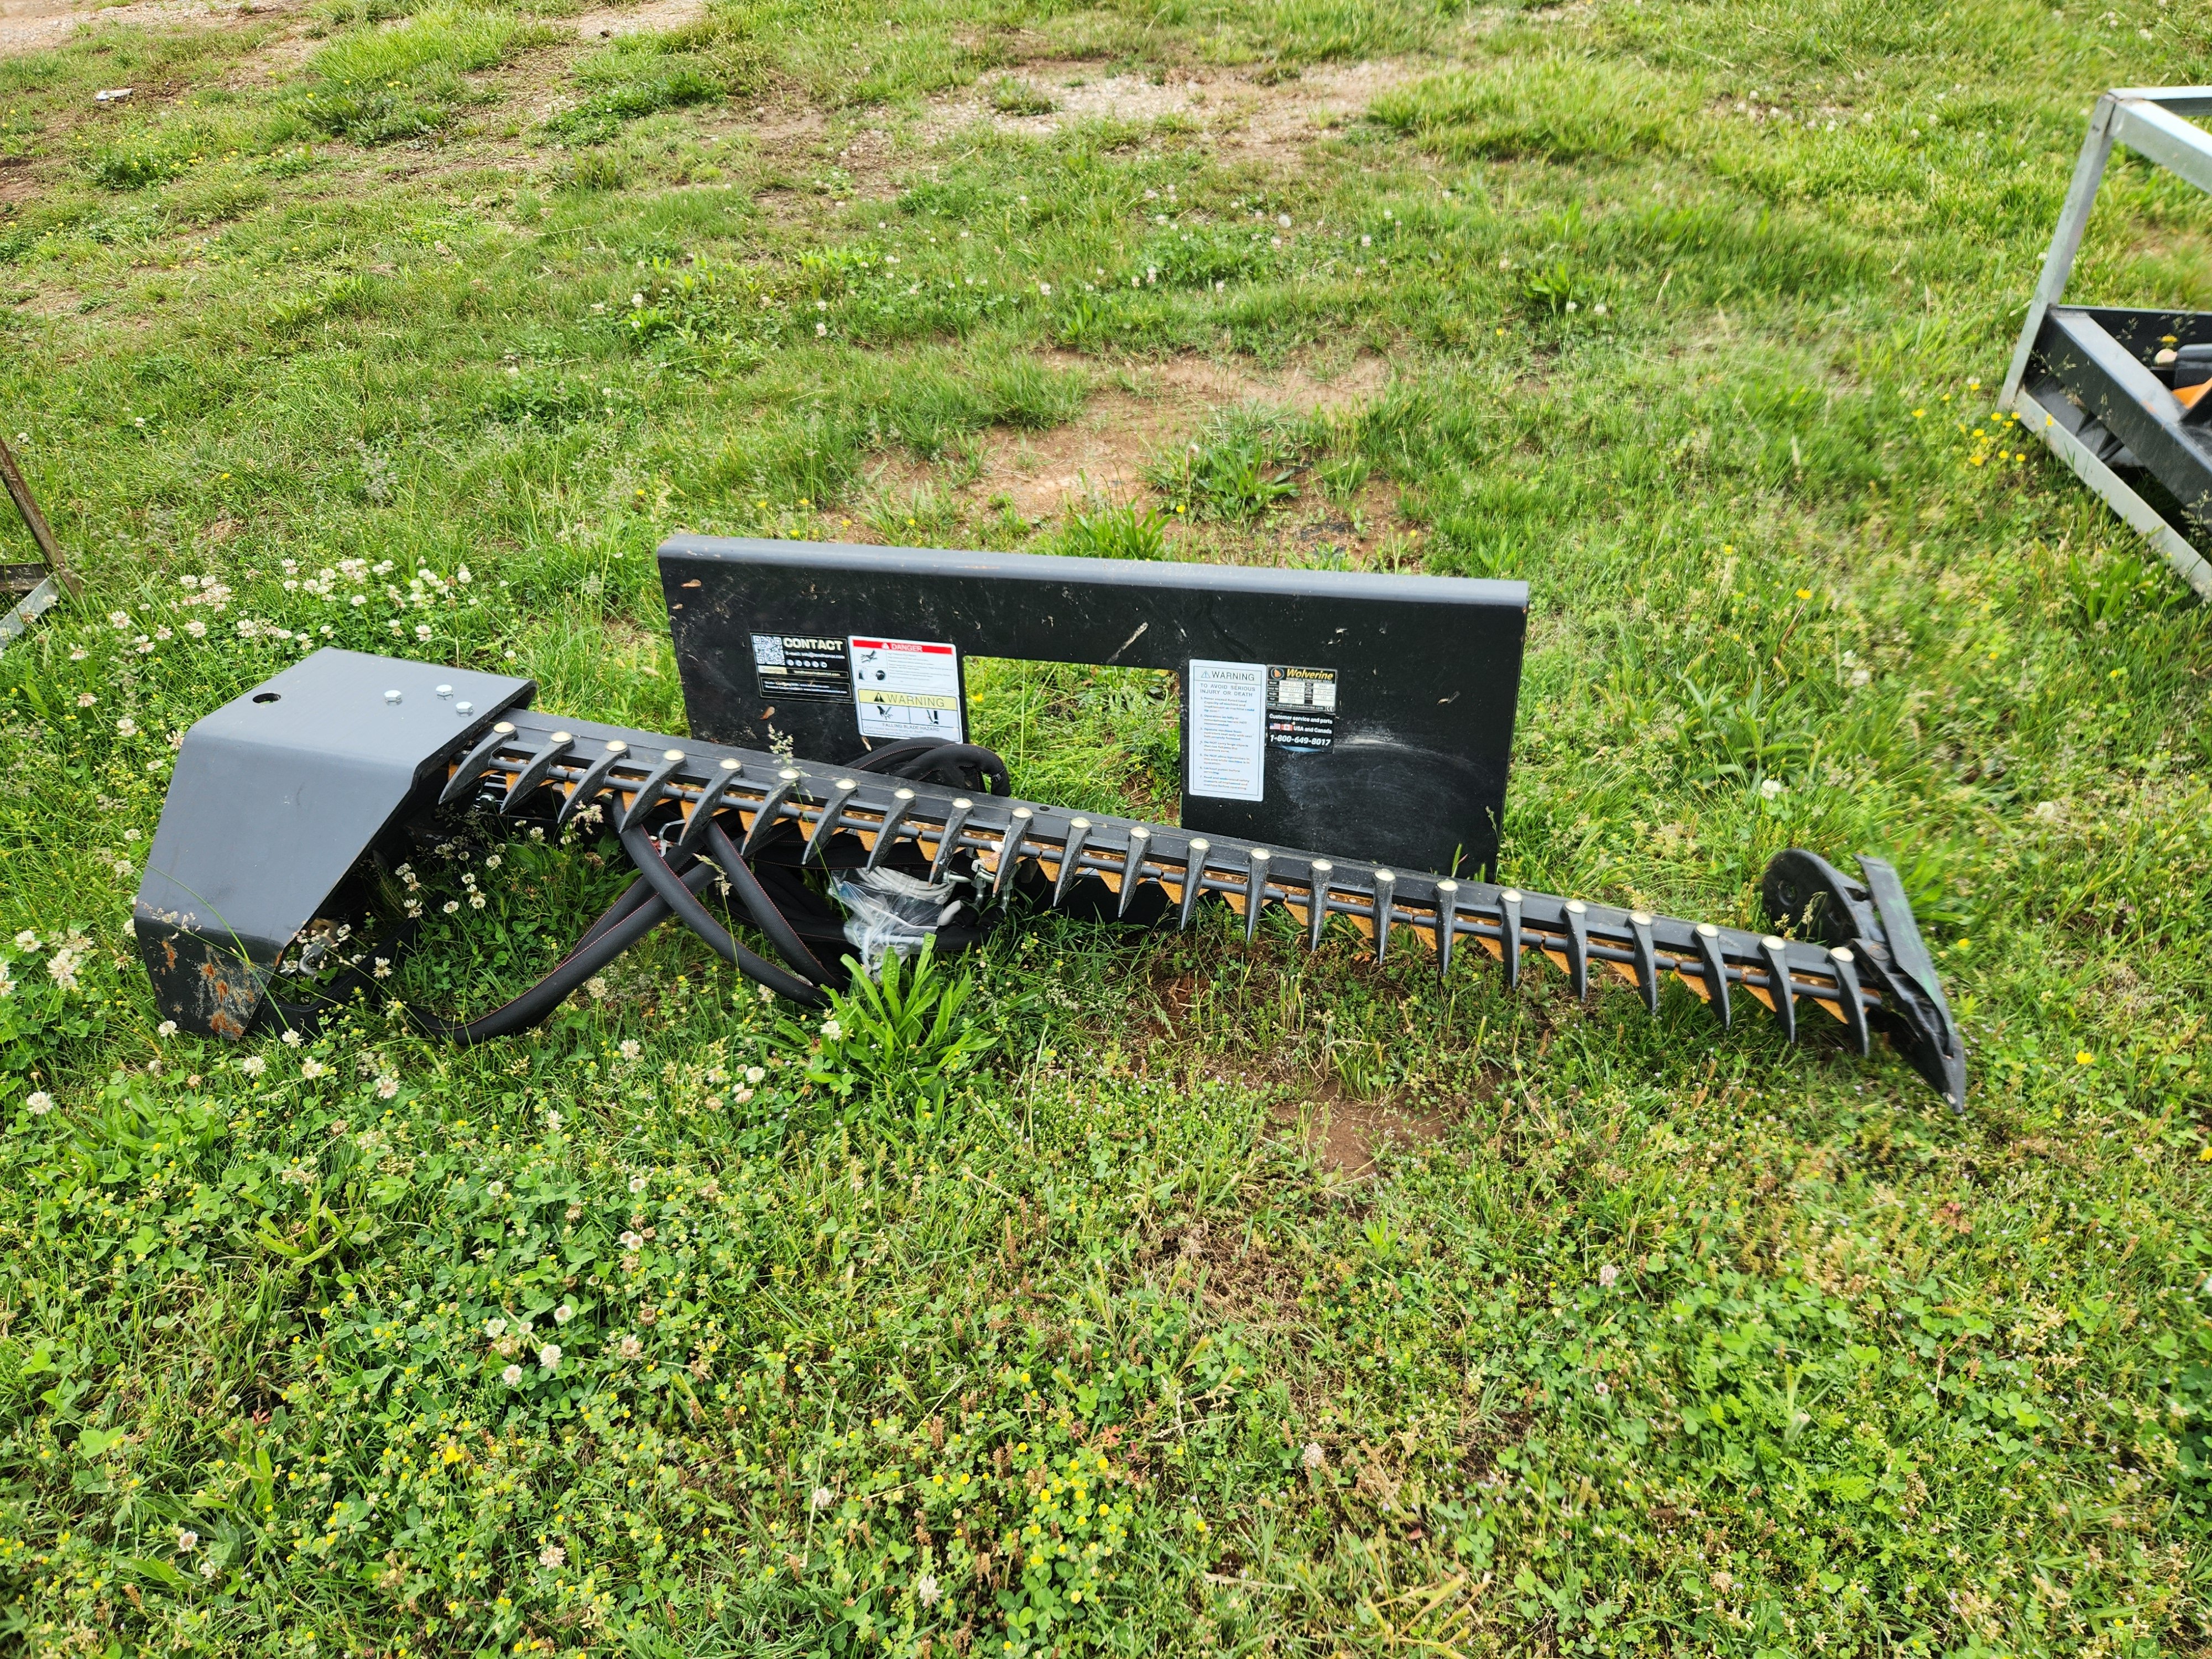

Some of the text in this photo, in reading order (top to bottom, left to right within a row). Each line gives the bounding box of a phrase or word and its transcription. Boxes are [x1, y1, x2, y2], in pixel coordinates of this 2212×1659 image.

[783, 637, 843, 651] CONTACT
[891, 643, 922, 652] DANGER
[1212, 671, 1255, 681] WARNING
[1287, 668, 1333, 680] Wolverine
[888, 694, 945, 707] WARNING
[1270, 734, 1331, 745] 1-800-649-8017
